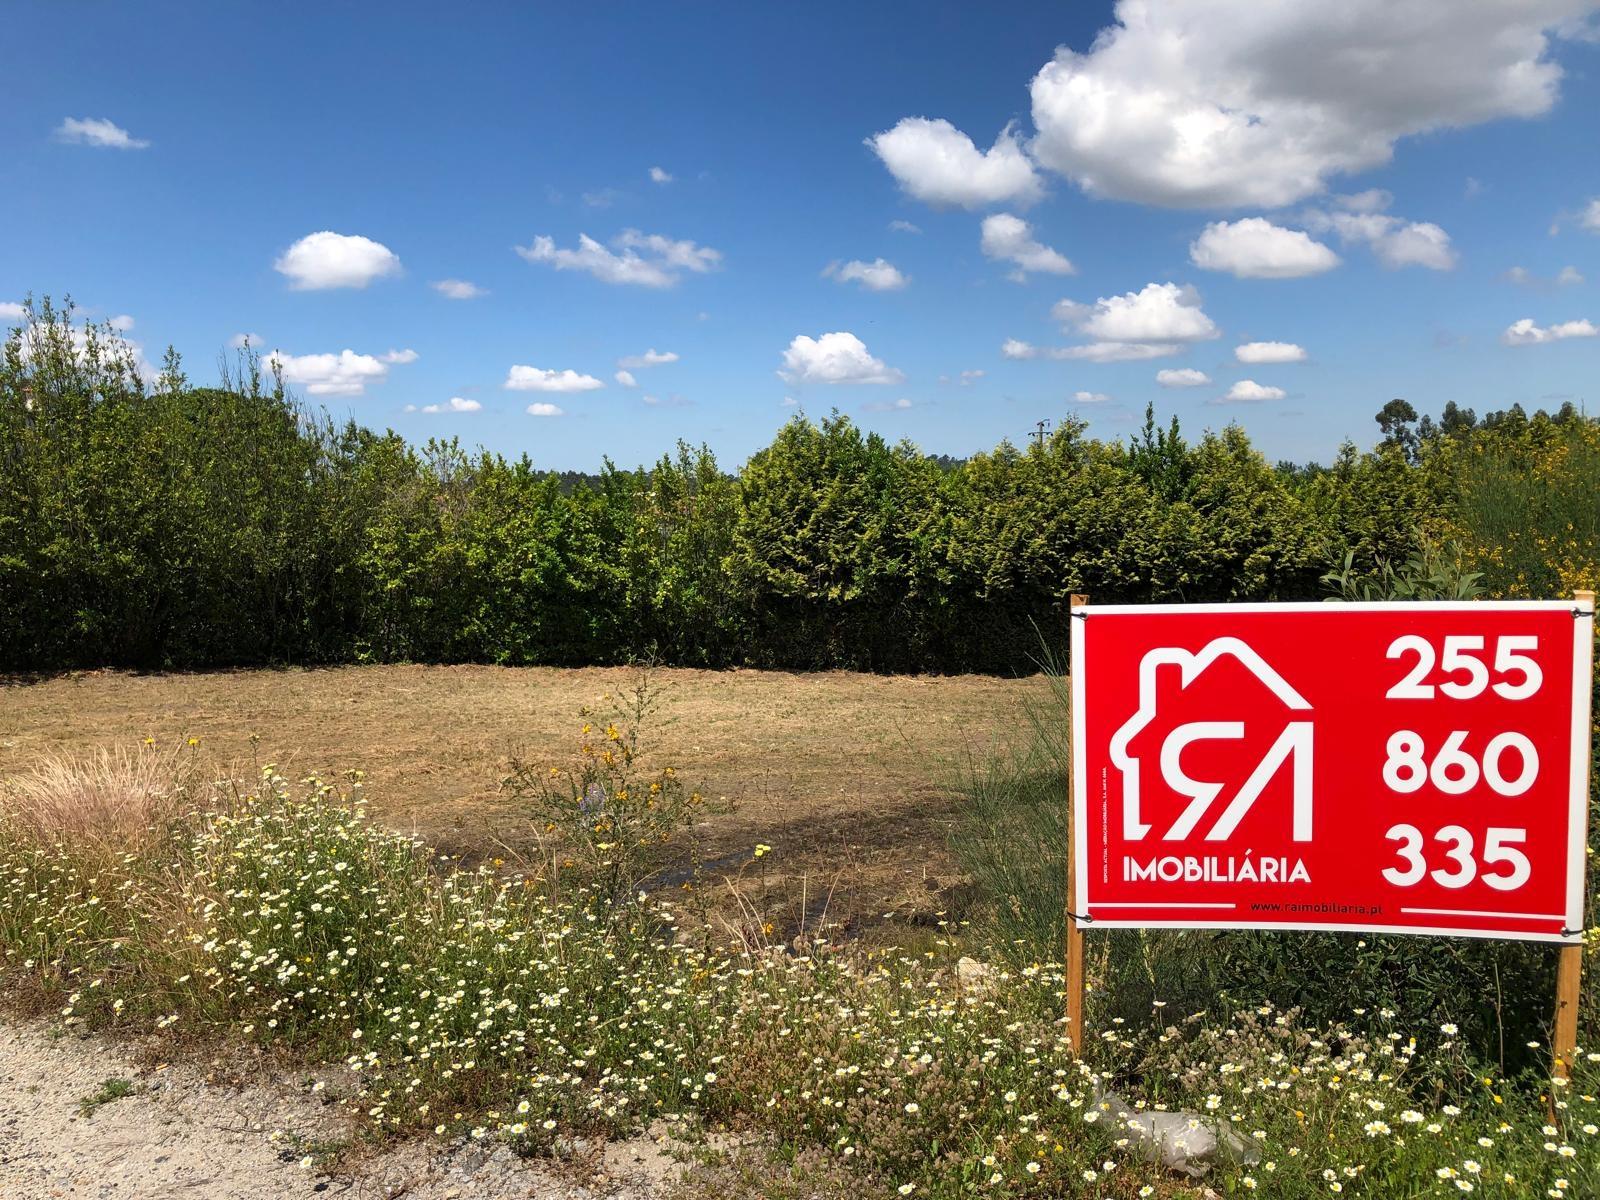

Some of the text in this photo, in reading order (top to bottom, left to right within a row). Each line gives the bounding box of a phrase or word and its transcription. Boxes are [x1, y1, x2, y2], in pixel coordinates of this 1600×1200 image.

[1386, 635, 1543, 700] 255
[1383, 730, 1539, 796] 860
[1124, 849, 1311, 882] IMOBILIÁRIA
[1382, 824, 1531, 890] 335
[1251, 902, 1382, 915] www.raimobiliaria.pt
